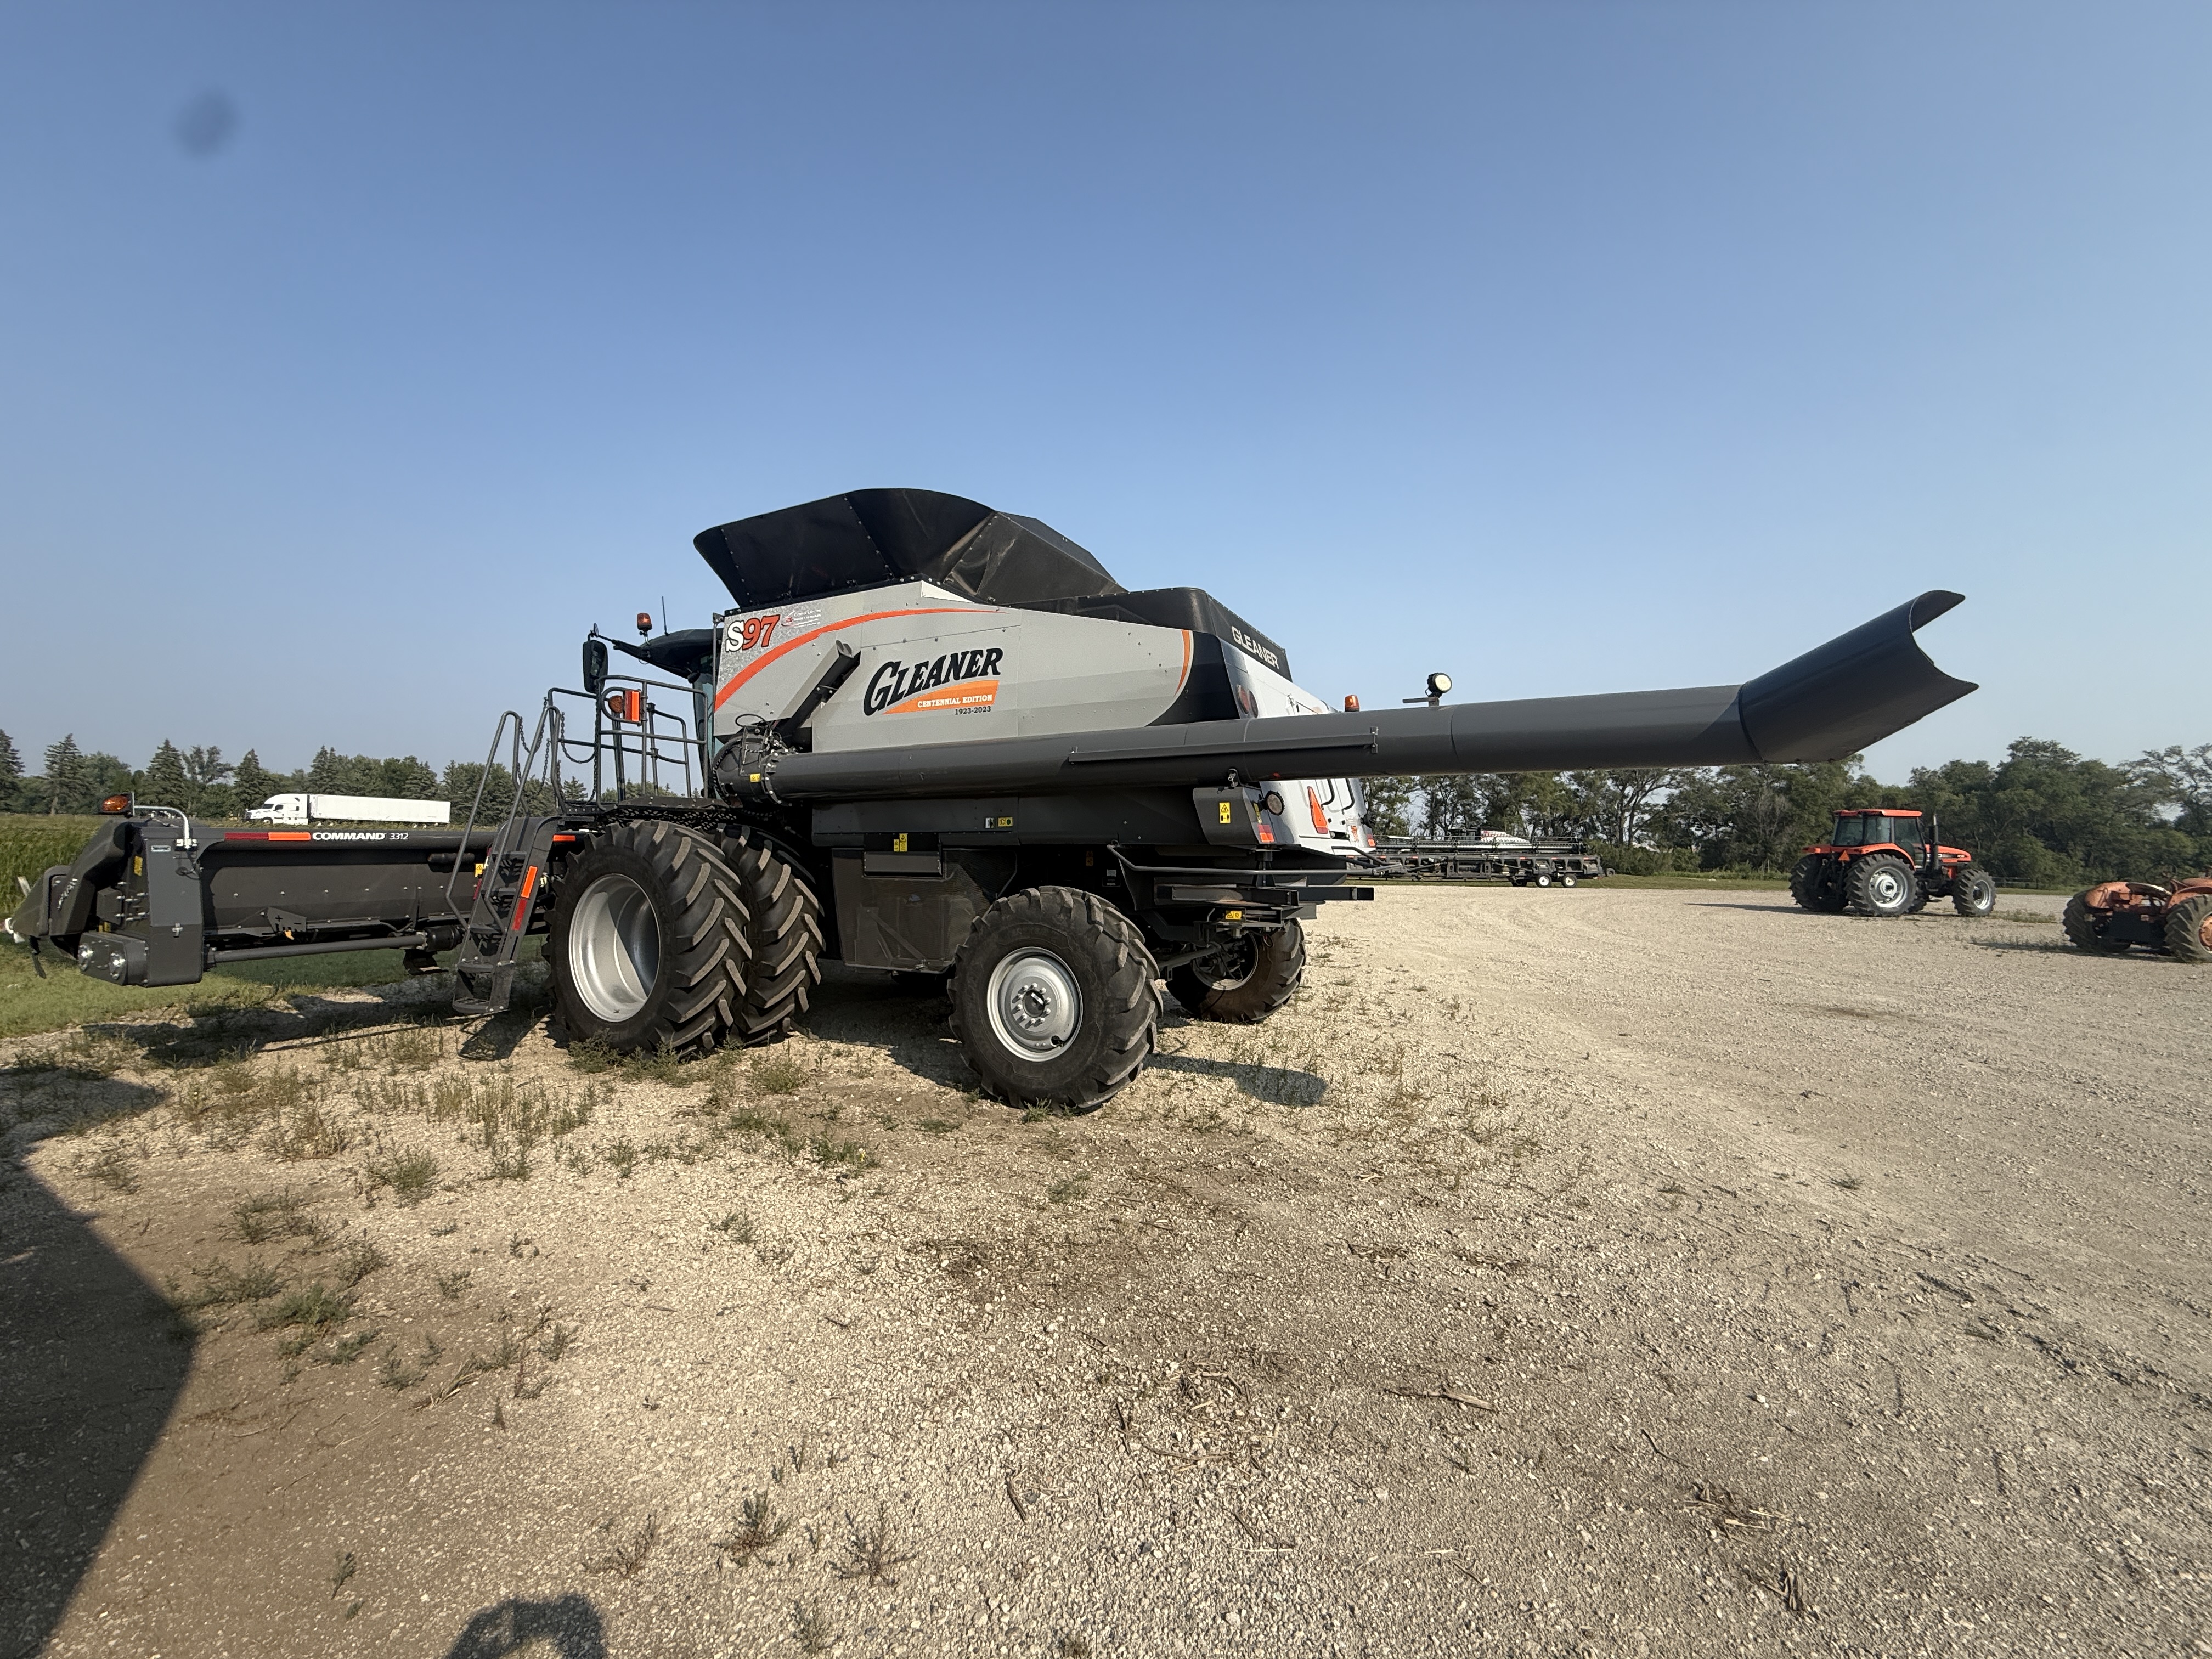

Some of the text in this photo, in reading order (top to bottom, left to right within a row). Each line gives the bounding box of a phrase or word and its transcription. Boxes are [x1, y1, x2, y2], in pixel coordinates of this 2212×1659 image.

[725, 614, 780, 653] S97
[1231, 625, 1279, 670] GLEANER
[863, 647, 1003, 716] GLEANER
[917, 694, 993, 708] CENTENNIAL EDITION
[955, 706, 991, 715] 1923-2023
[312, 831, 409, 841] COMMAND 3312
